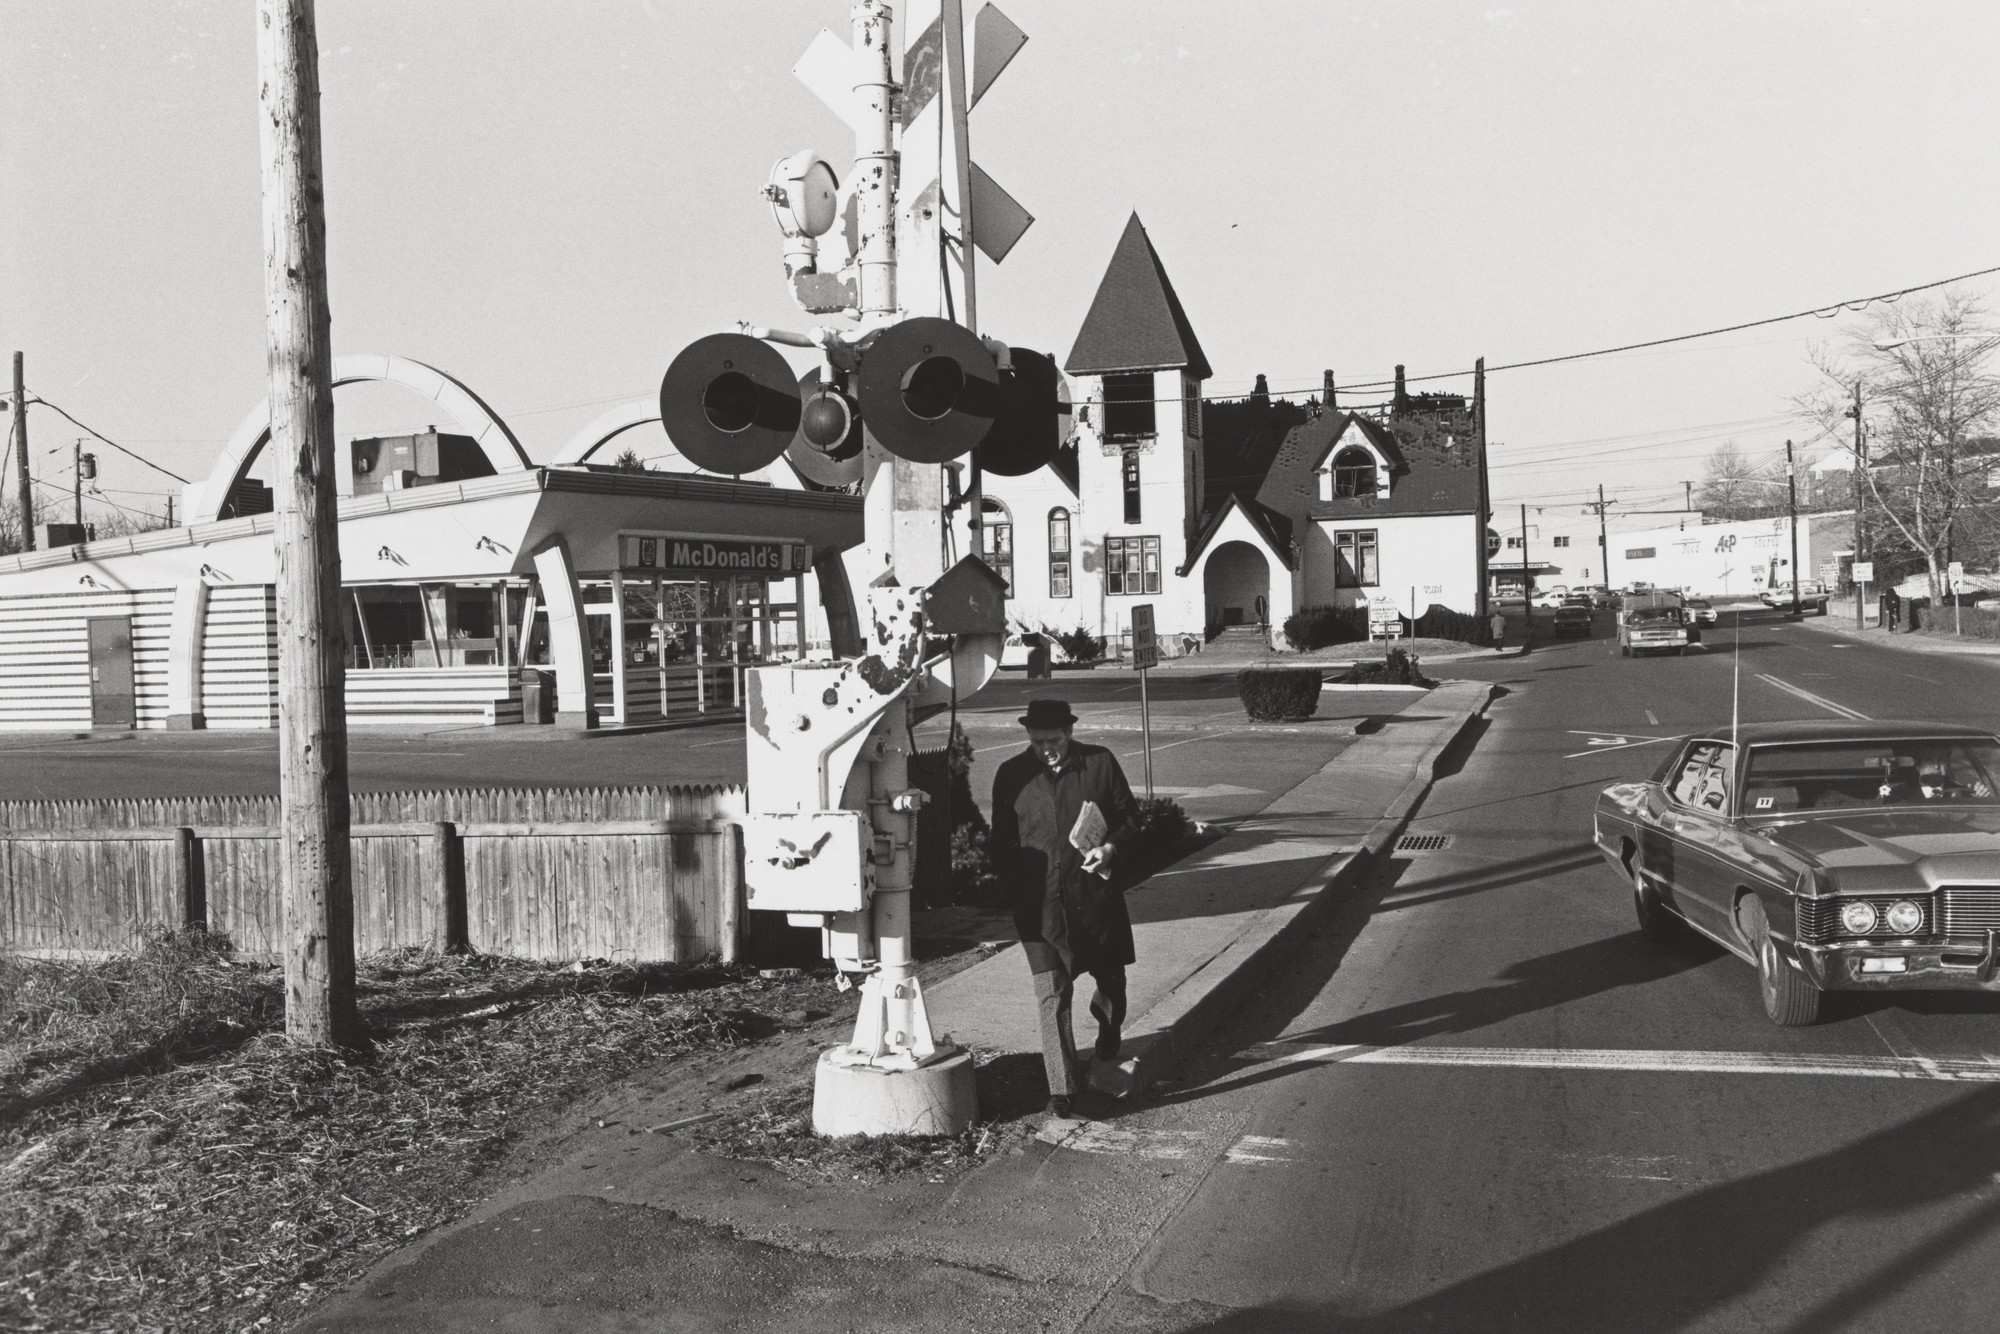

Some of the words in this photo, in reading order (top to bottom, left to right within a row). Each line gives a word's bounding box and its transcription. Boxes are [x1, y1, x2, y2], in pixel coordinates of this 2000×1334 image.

[1714, 534, 1737, 553] A&P
[672, 542, 779, 568] McDonald's
[1139, 610, 1148, 626] DO
[1138, 629, 1150, 645] NOT
[1135, 646, 1156, 664] ENTER
